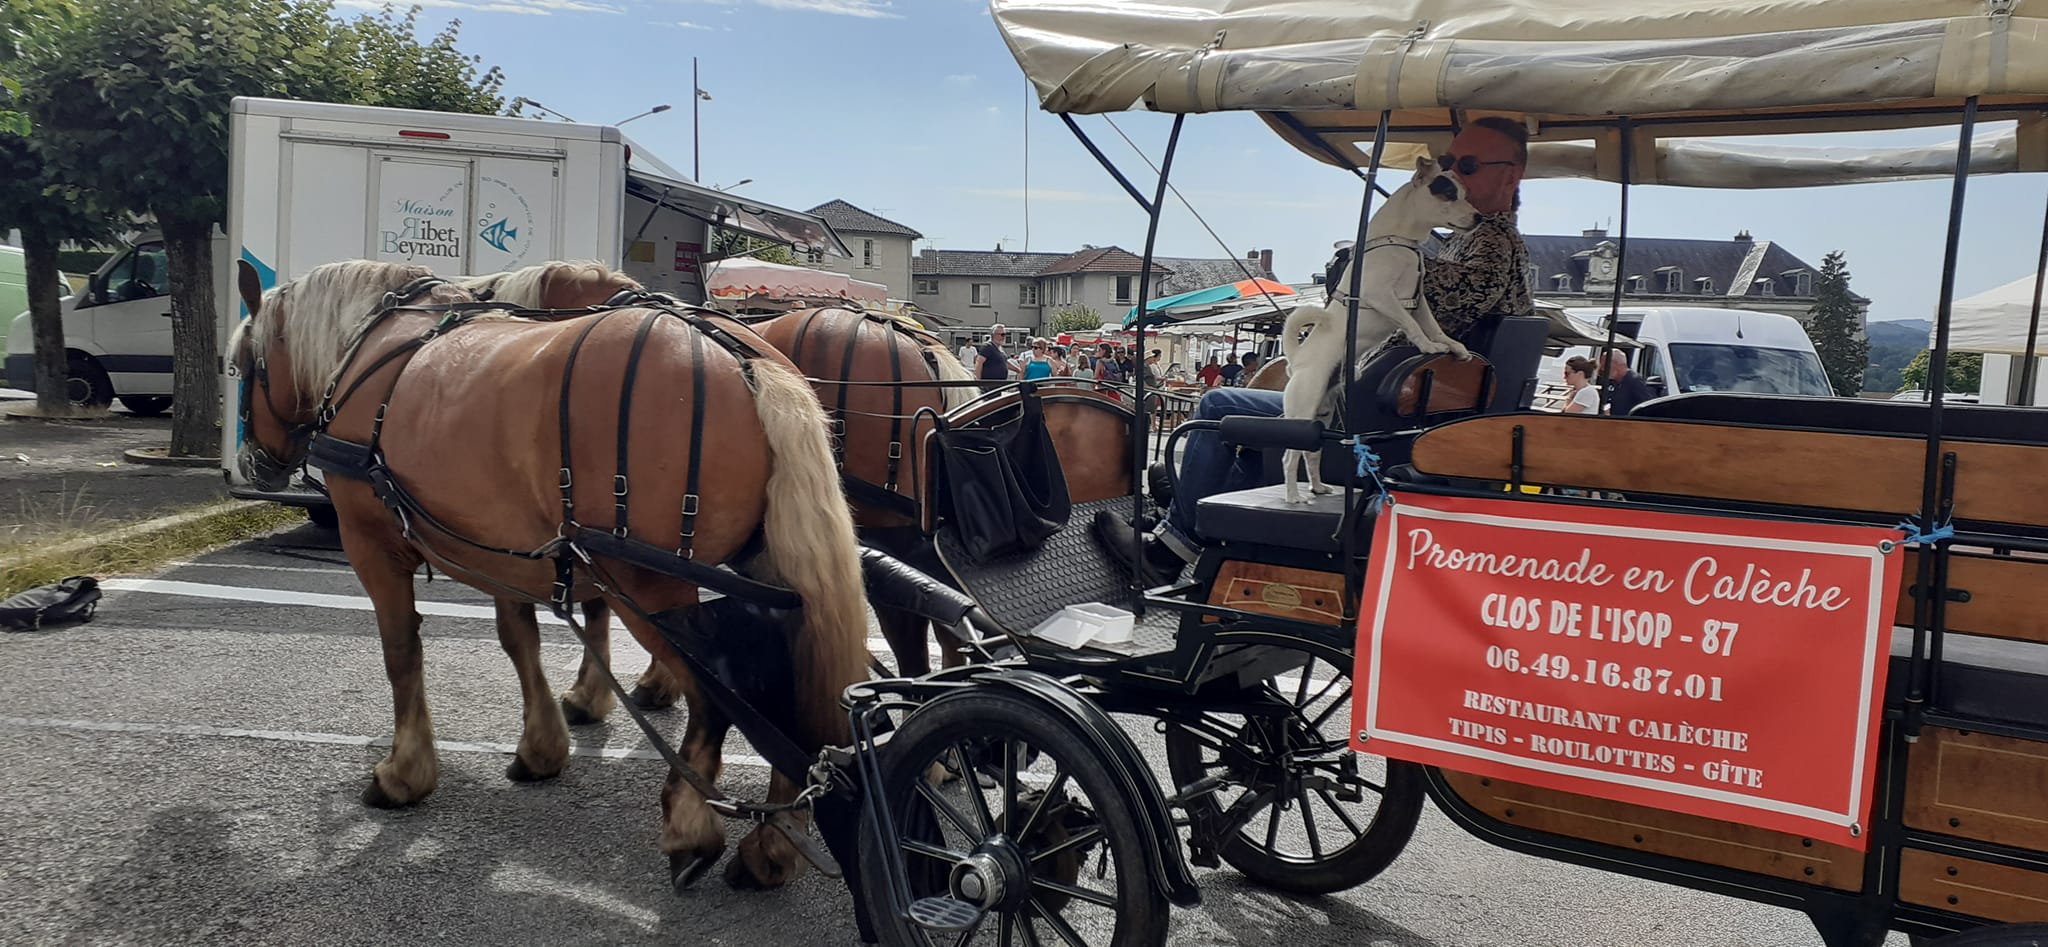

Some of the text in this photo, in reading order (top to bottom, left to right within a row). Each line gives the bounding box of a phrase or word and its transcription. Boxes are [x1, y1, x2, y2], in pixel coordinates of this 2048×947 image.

[396, 199, 454, 217] Maison
[380, 231, 460, 261] Beyrand
[1408, 528, 1850, 611] Promenade en Calèche
[1481, 593, 1739, 656] CLOS DE L'ISOP - 87
[1486, 645, 1723, 701] 06.49.16.87.01
[1463, 690, 1748, 752] RESTAURANT CALÈCHE
[1449, 717, 1763, 789] TIPIS - ROULOTTES - GÎTE
